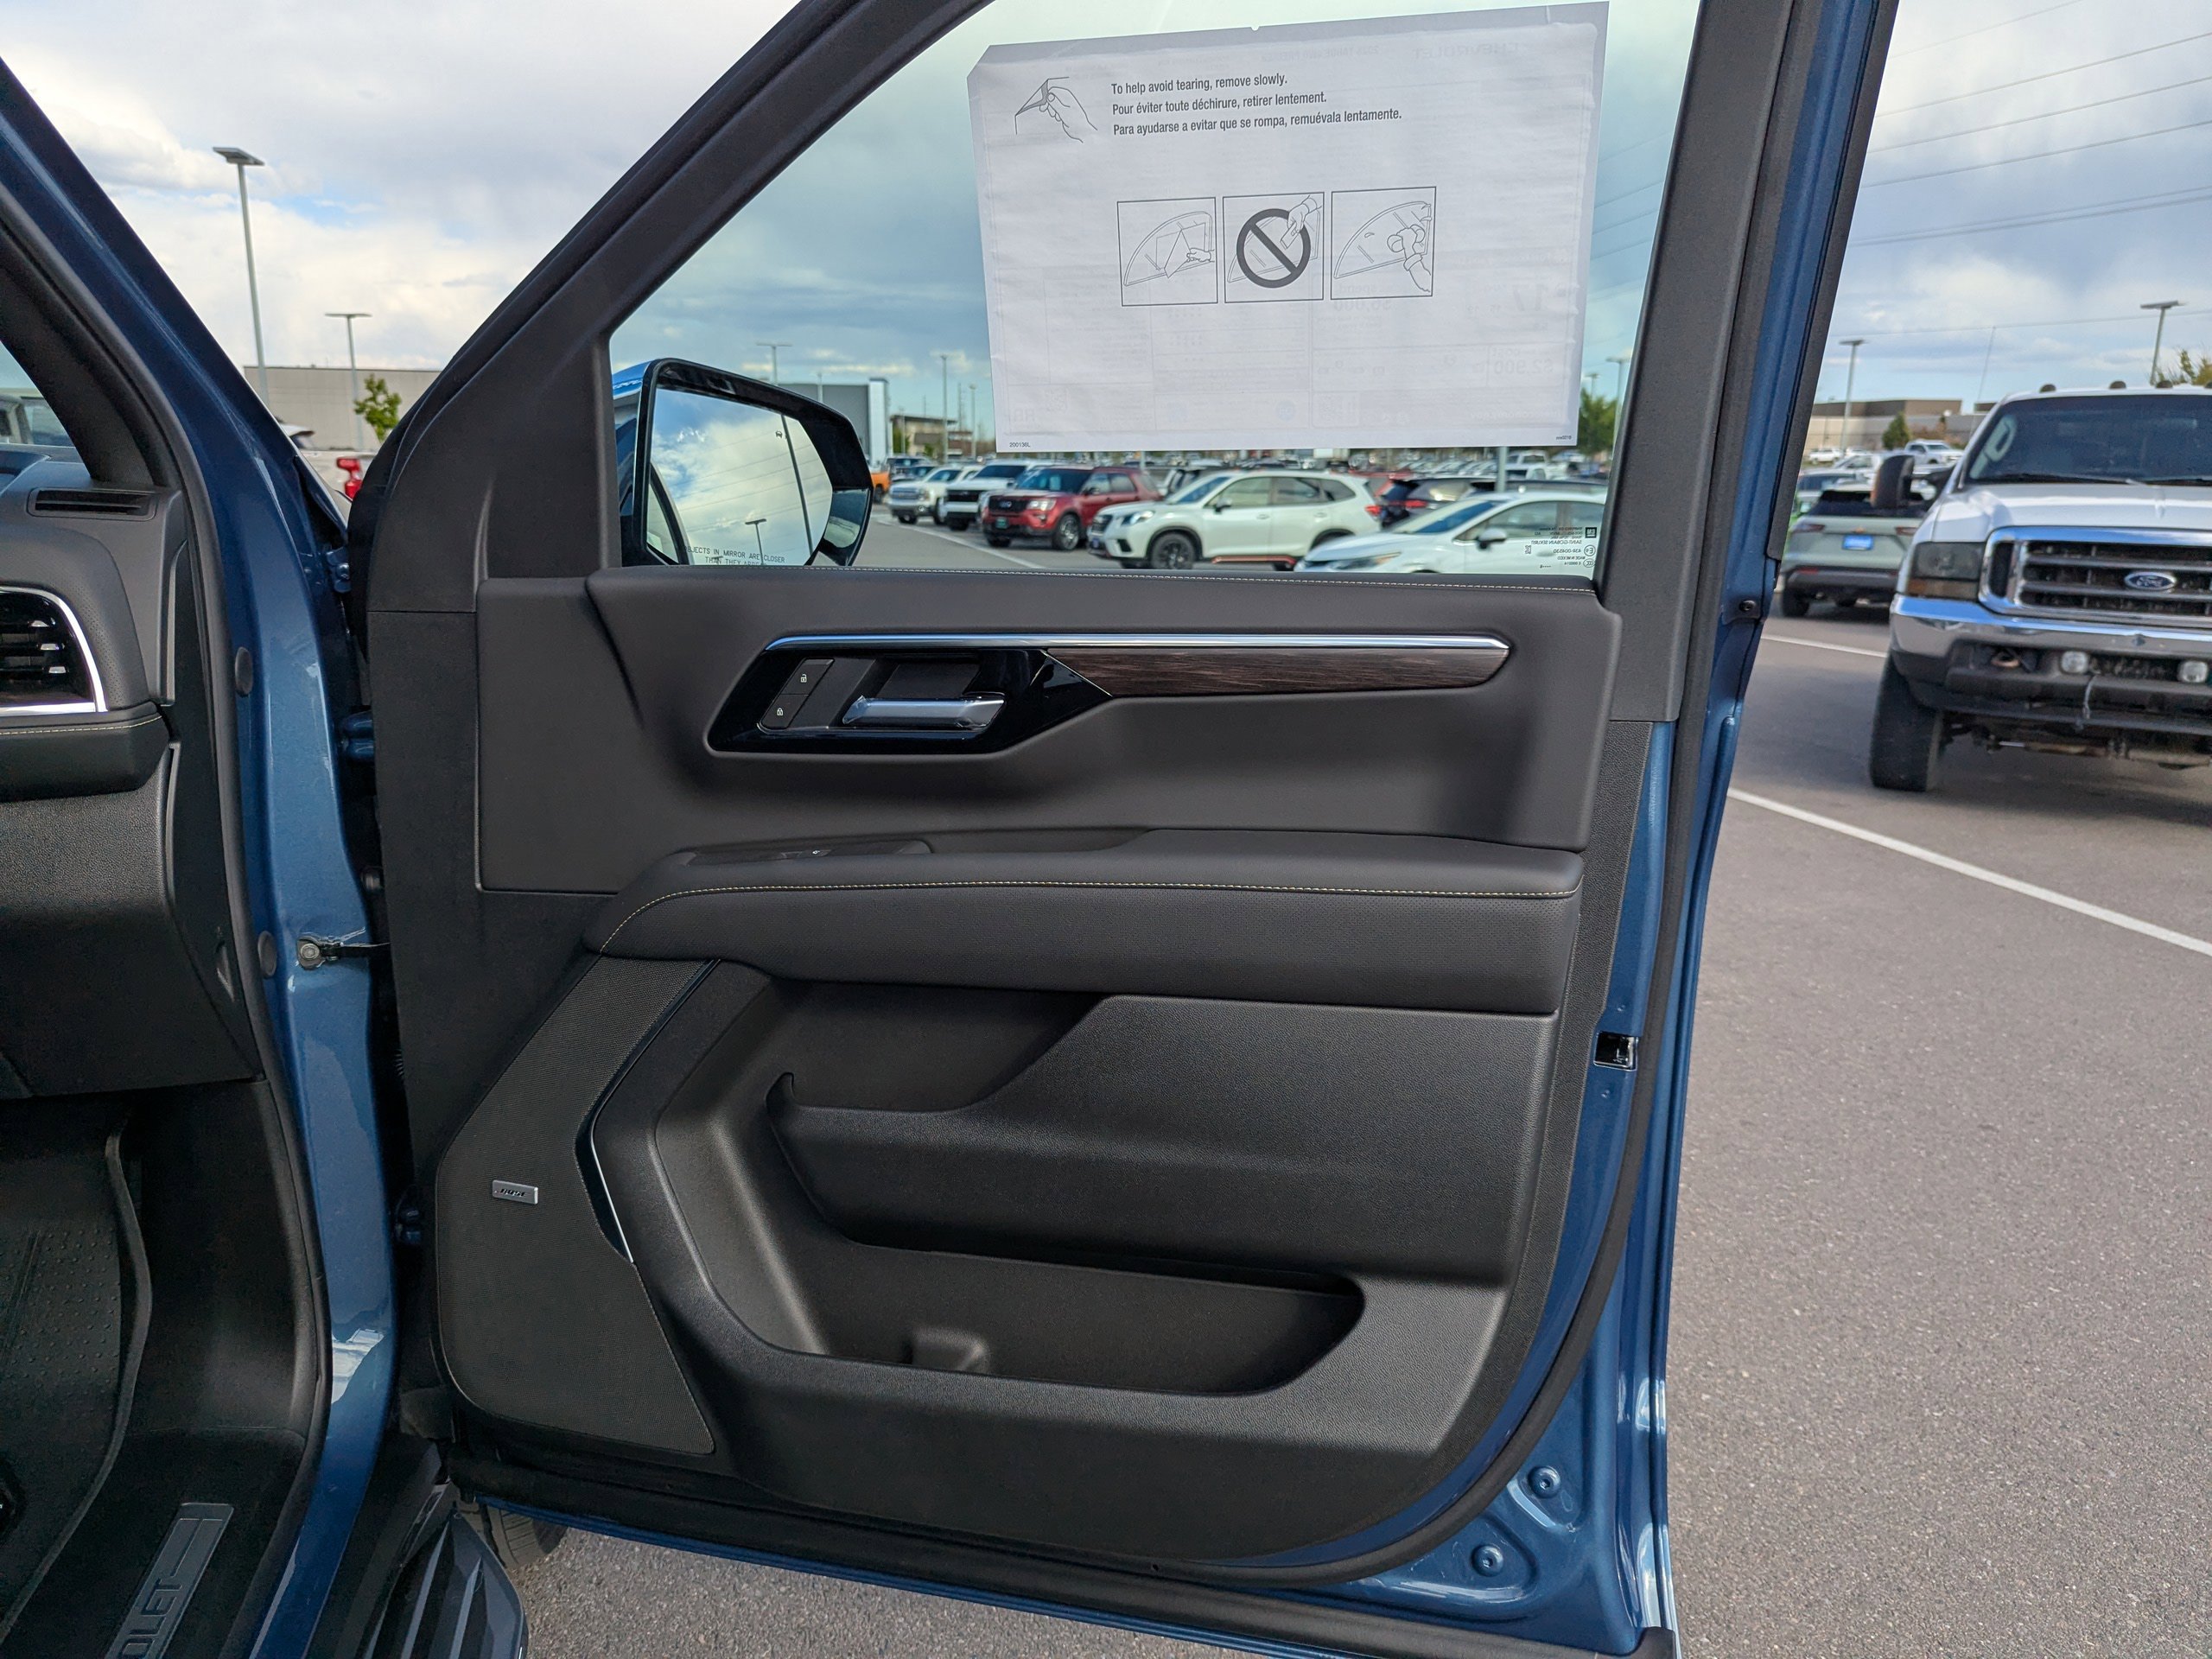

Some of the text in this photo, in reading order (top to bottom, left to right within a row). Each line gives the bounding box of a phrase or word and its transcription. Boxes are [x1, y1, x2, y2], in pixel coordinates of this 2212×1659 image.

[1111, 73, 1287, 95] To help avoid tearing, remove slowly.
[1112, 92, 1327, 115] Pour éviter toute déchirure, retirer lentement.
[1114, 124, 1135, 136] Para
[1137, 122, 1179, 137] ayudarse
[1191, 119, 1217, 131] evitar
[1219, 119, 1237, 131] que
[1240, 118, 1251, 129] se
[1254, 116, 1287, 129] rompa,
[1290, 111, 1341, 125] remuévala
[1344, 108, 1402, 122] lentamente.
[723, 550, 746, 558] MIRROR
[763, 555, 785, 563] CLOSER
